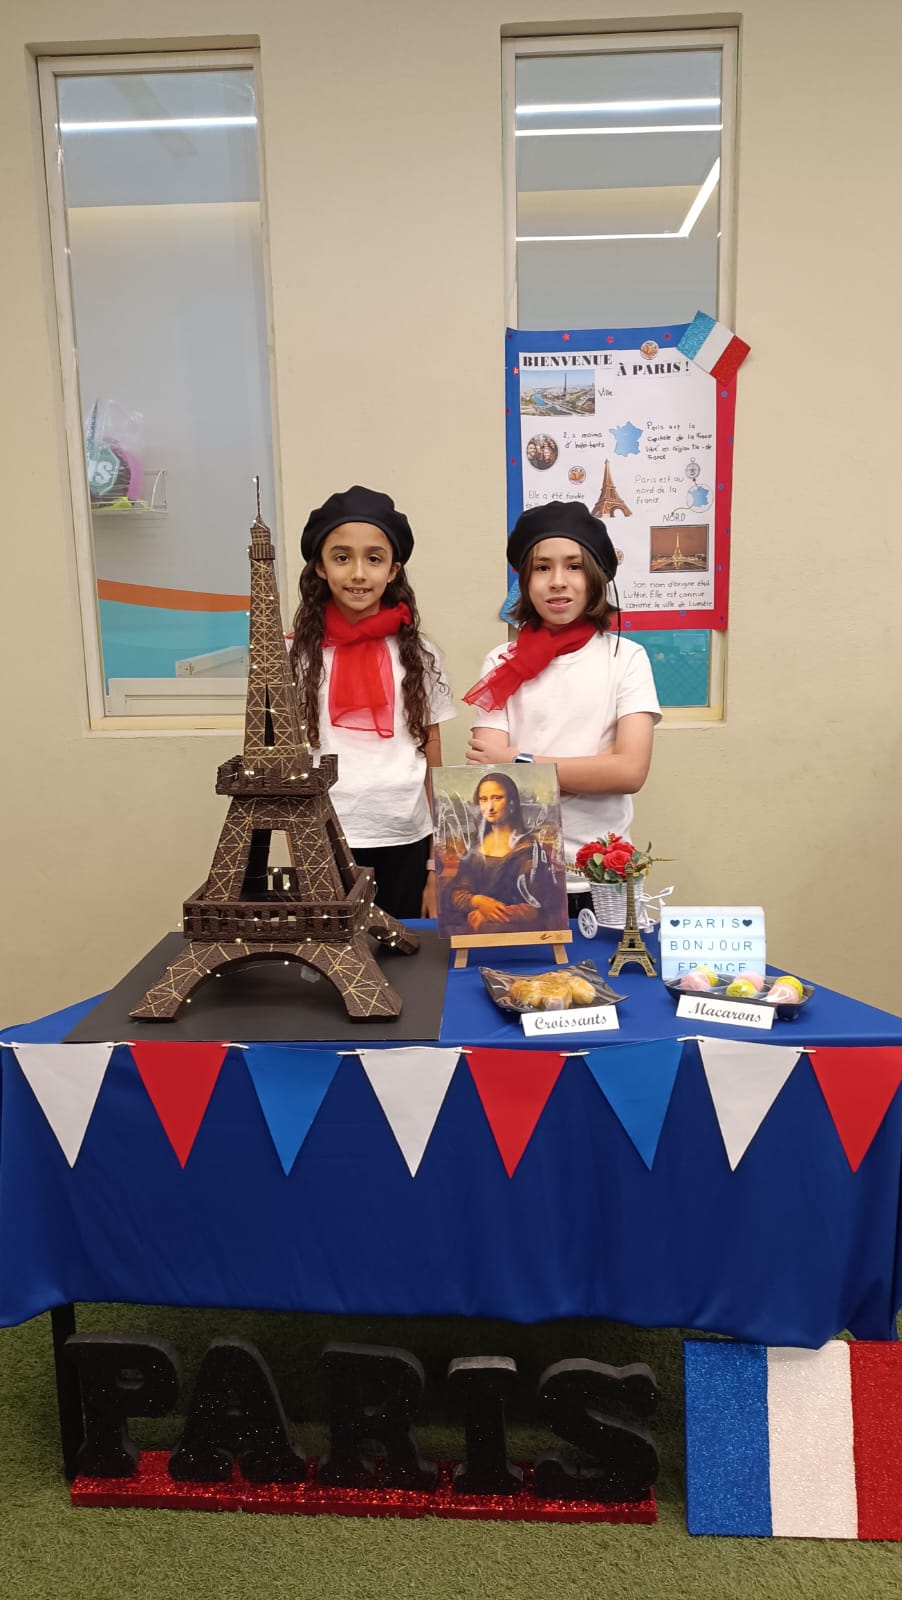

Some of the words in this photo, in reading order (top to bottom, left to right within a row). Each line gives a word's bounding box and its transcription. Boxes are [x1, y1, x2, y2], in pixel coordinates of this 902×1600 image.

[523, 354, 613, 367] BIENVENUE
[617, 362, 627, 376] À
[632, 362, 681, 376] PARIS
[635, 474, 657, 483] Paris
[663, 513, 686, 522] NORD
[682, 918, 740, 929] PARIS
[670, 939, 753, 951] BONJOUR
[678, 962, 747, 972] FRNCE
[688, 1002, 761, 1022] Macarons
[534, 1013, 607, 1030] Croissants
[65, 1332, 659, 1500] PARIS
